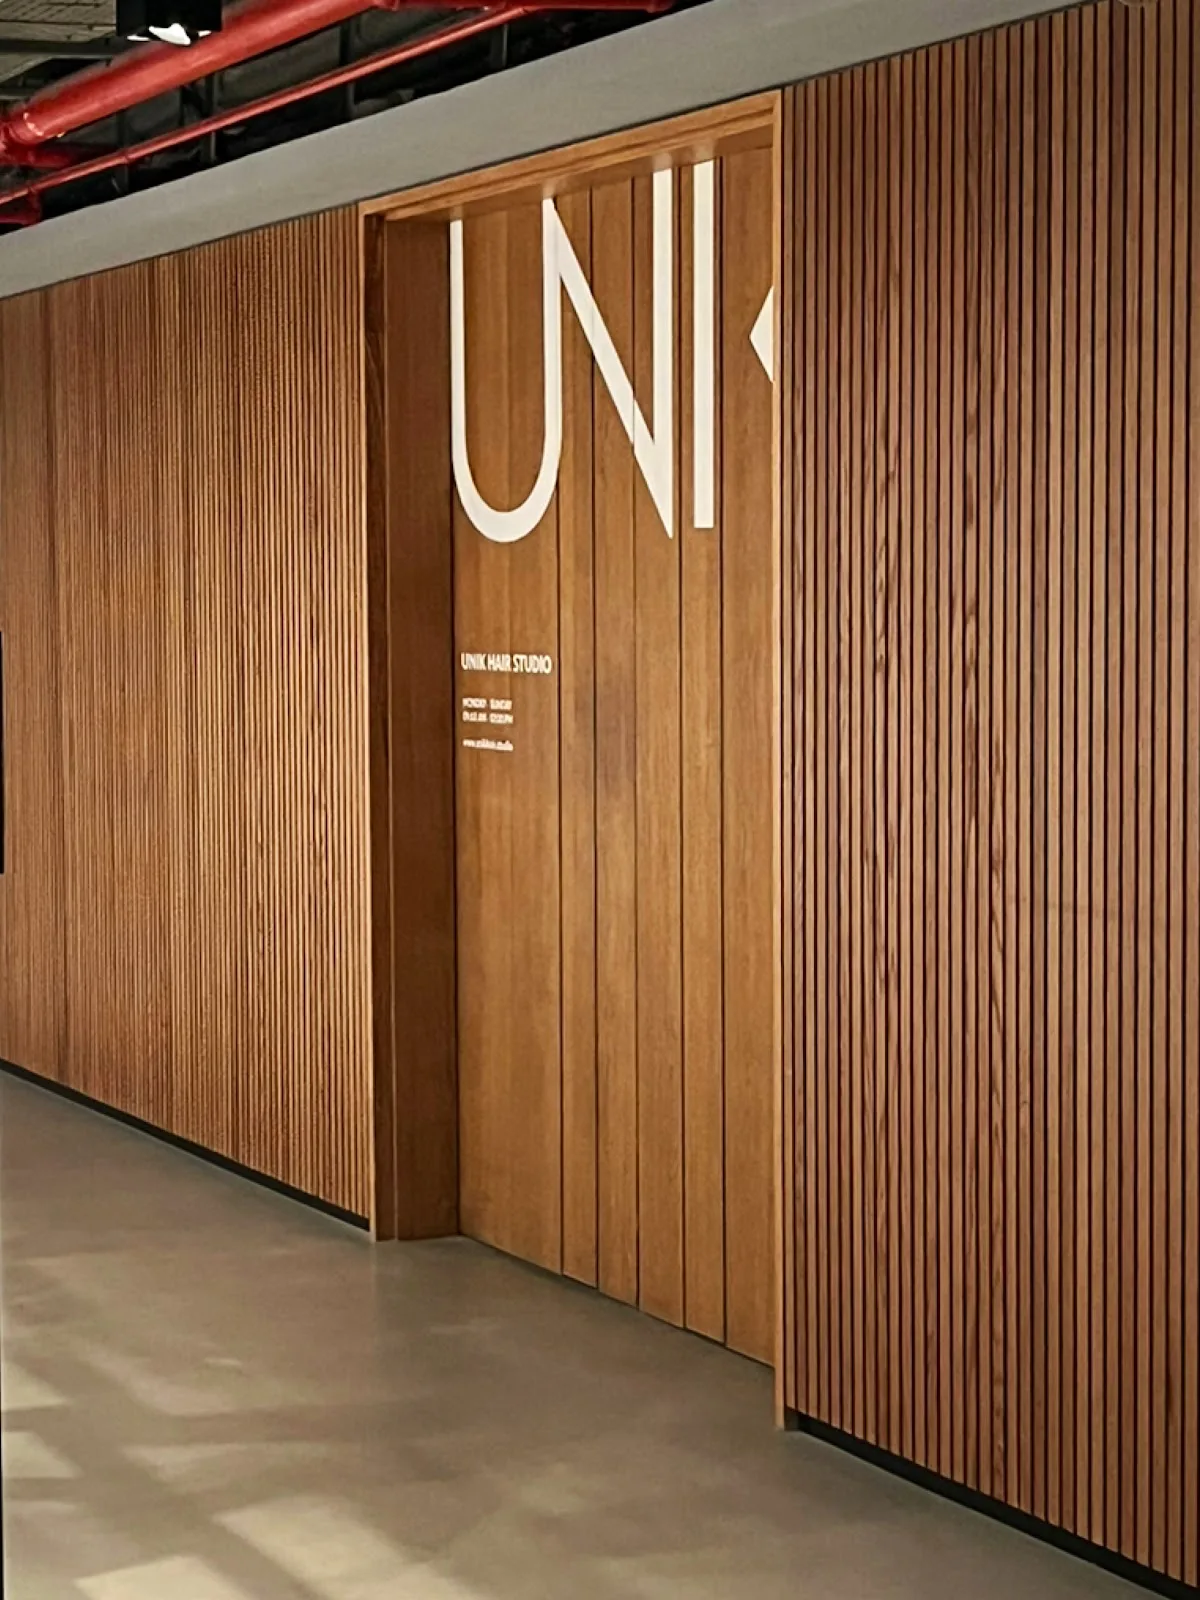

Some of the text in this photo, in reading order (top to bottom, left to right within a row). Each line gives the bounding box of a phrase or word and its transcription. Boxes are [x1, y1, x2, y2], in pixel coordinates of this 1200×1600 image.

[449, 159, 774, 543] UNI
[460, 652, 552, 674] UNIK HAIR STUDIO
